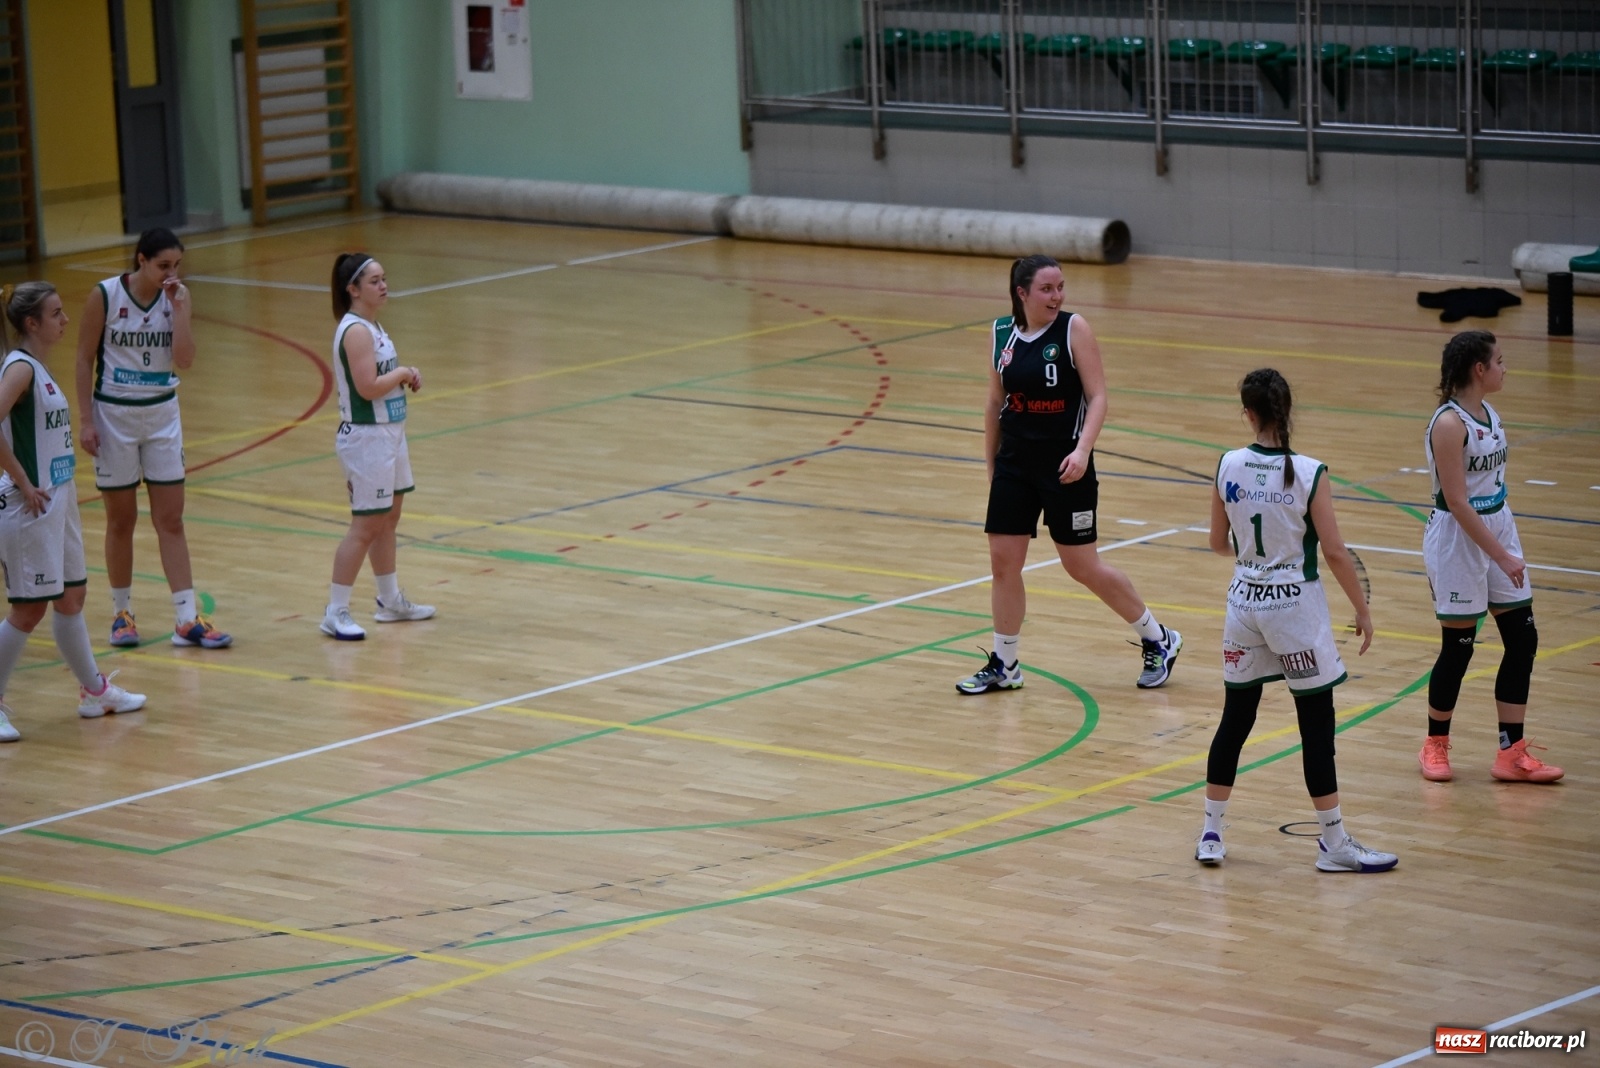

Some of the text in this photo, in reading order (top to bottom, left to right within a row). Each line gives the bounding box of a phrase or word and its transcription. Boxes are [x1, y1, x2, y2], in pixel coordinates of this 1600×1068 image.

[110, 329, 173, 348] KATOWIC
[142, 351, 151, 367] 6
[1045, 363, 1058, 387] 9
[1027, 399, 1065, 411] KAMAN
[1225, 481, 1295, 506] KOMPLIDO
[1250, 513, 1266, 558] 1
